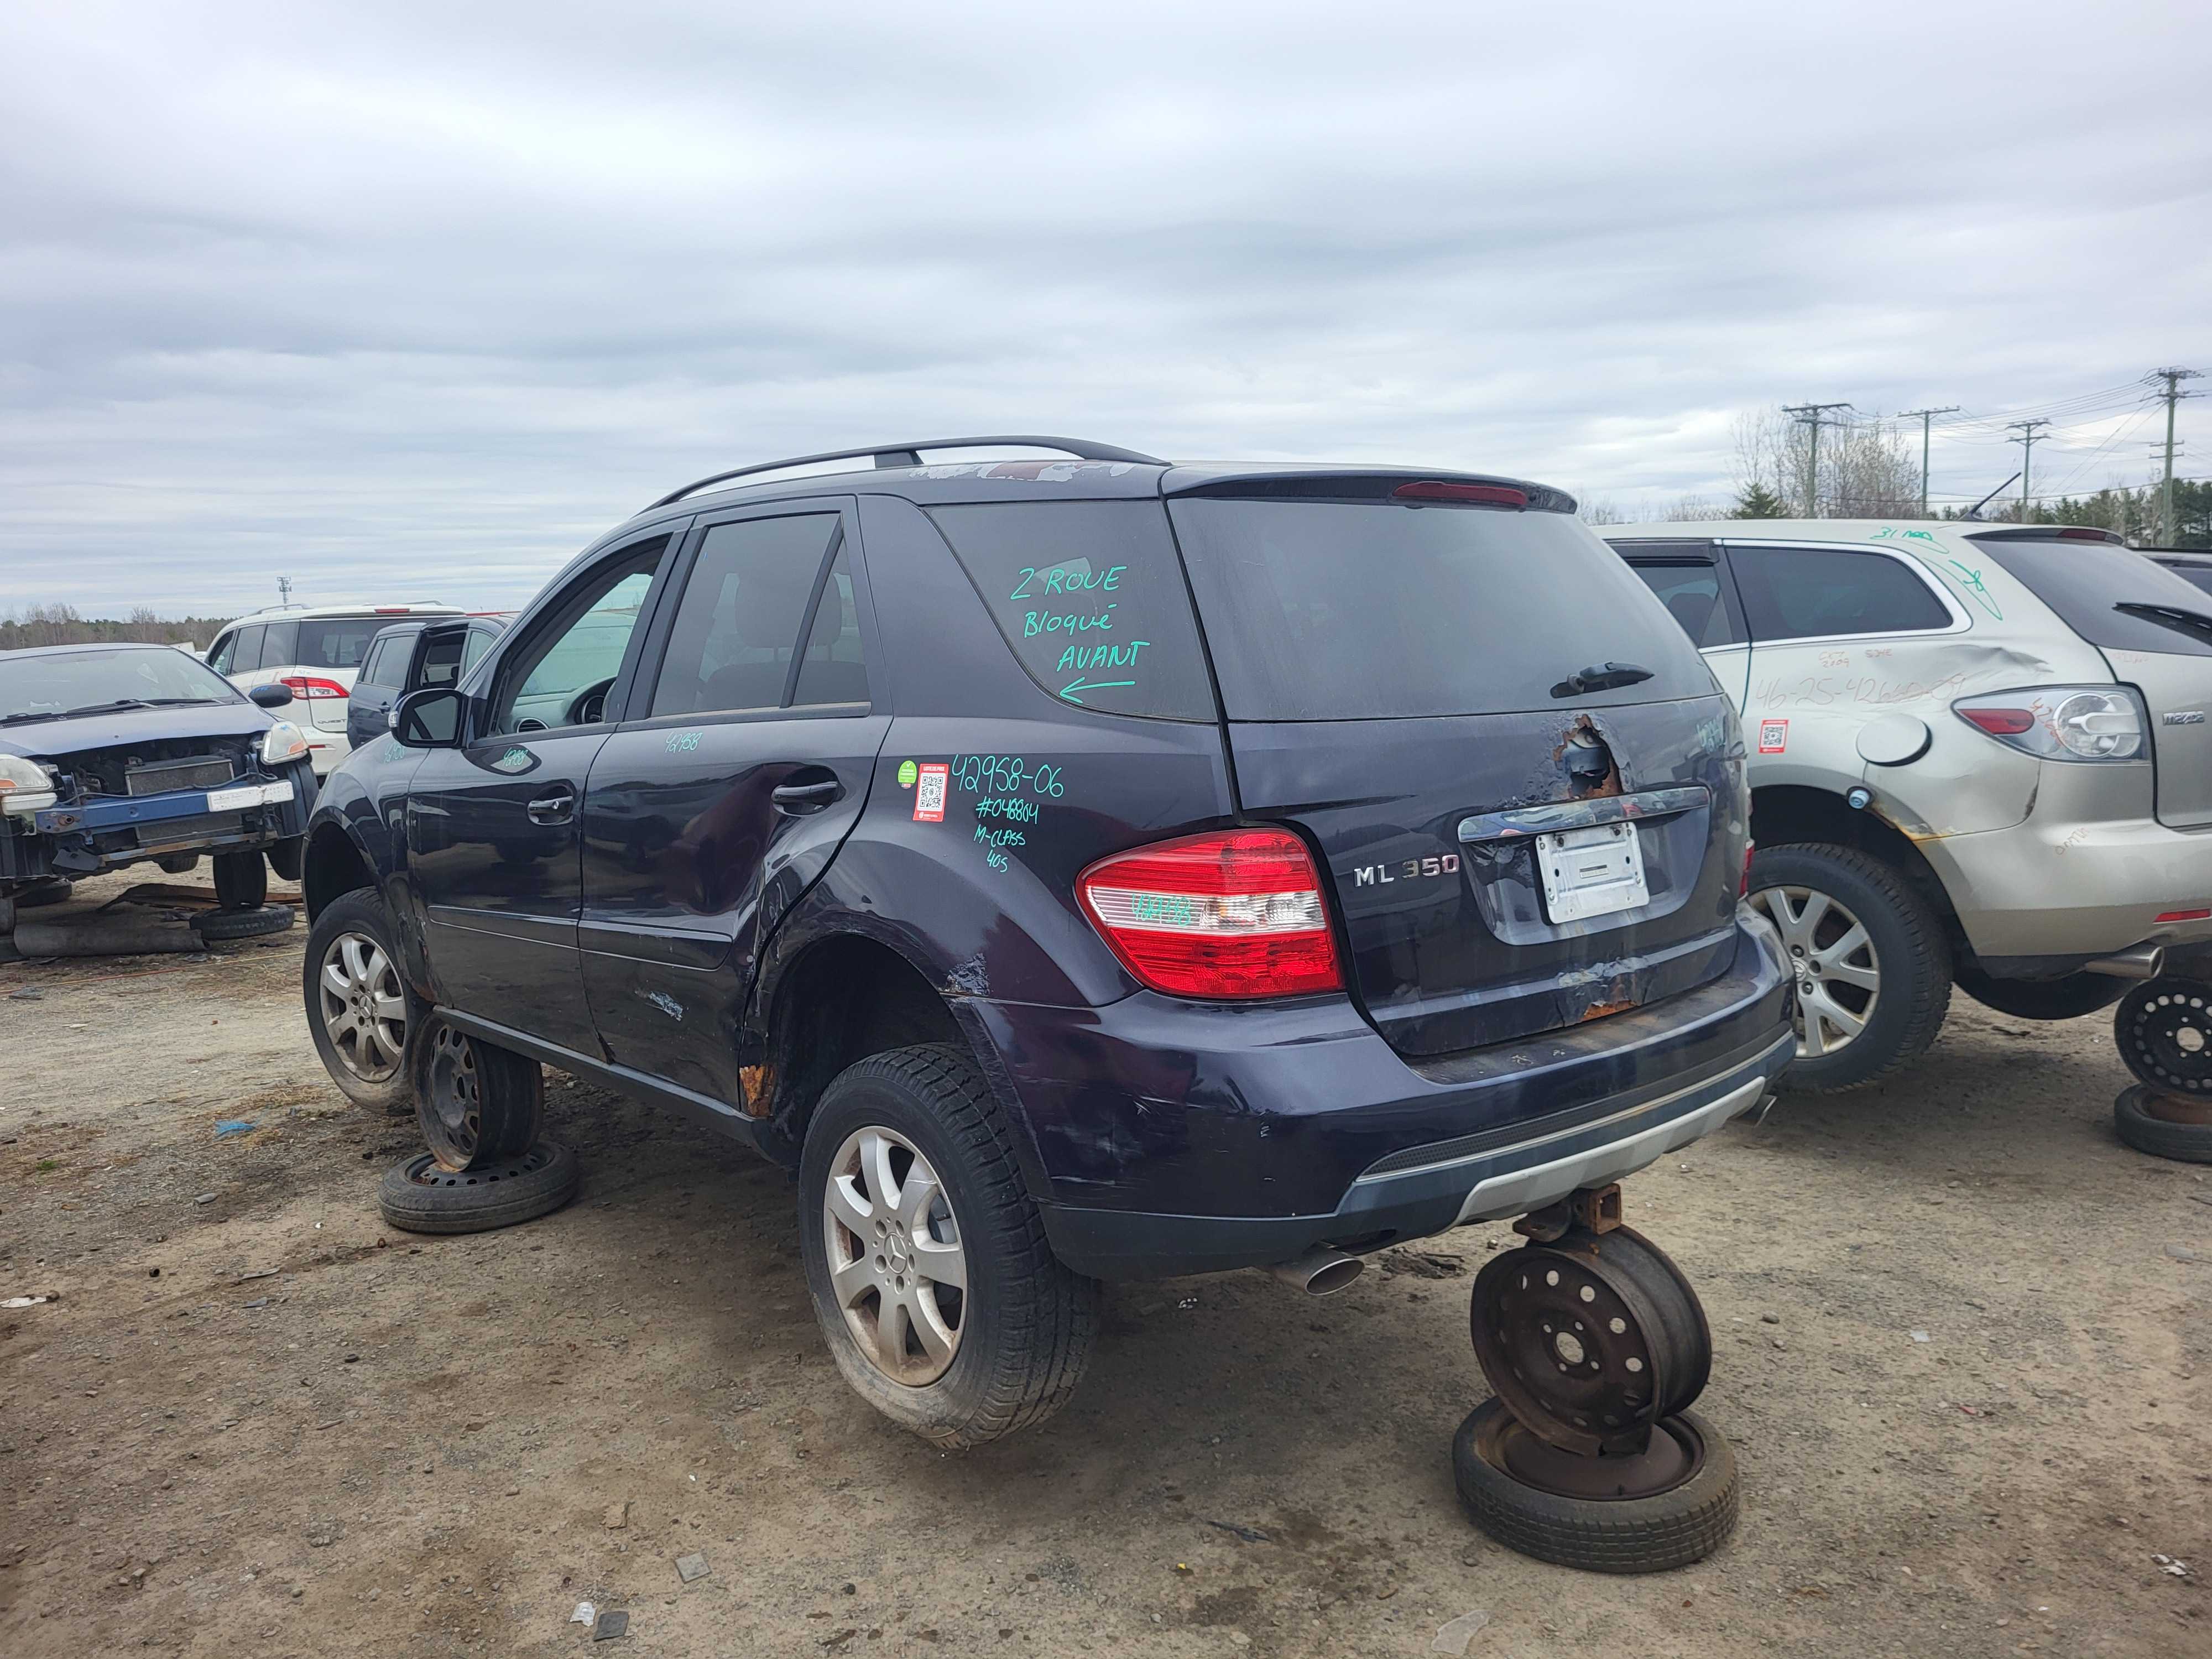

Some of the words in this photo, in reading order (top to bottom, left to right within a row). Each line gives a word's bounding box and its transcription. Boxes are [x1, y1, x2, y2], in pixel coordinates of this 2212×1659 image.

[1044, 566, 1128, 596] ROUE
[1056, 641, 1150, 672] AVANT
[951, 754, 1063, 797] 42958-06
[973, 824, 1026, 847] M-CLASS
[1354, 864, 1395, 887] ML
[1402, 854, 1460, 879] 350
